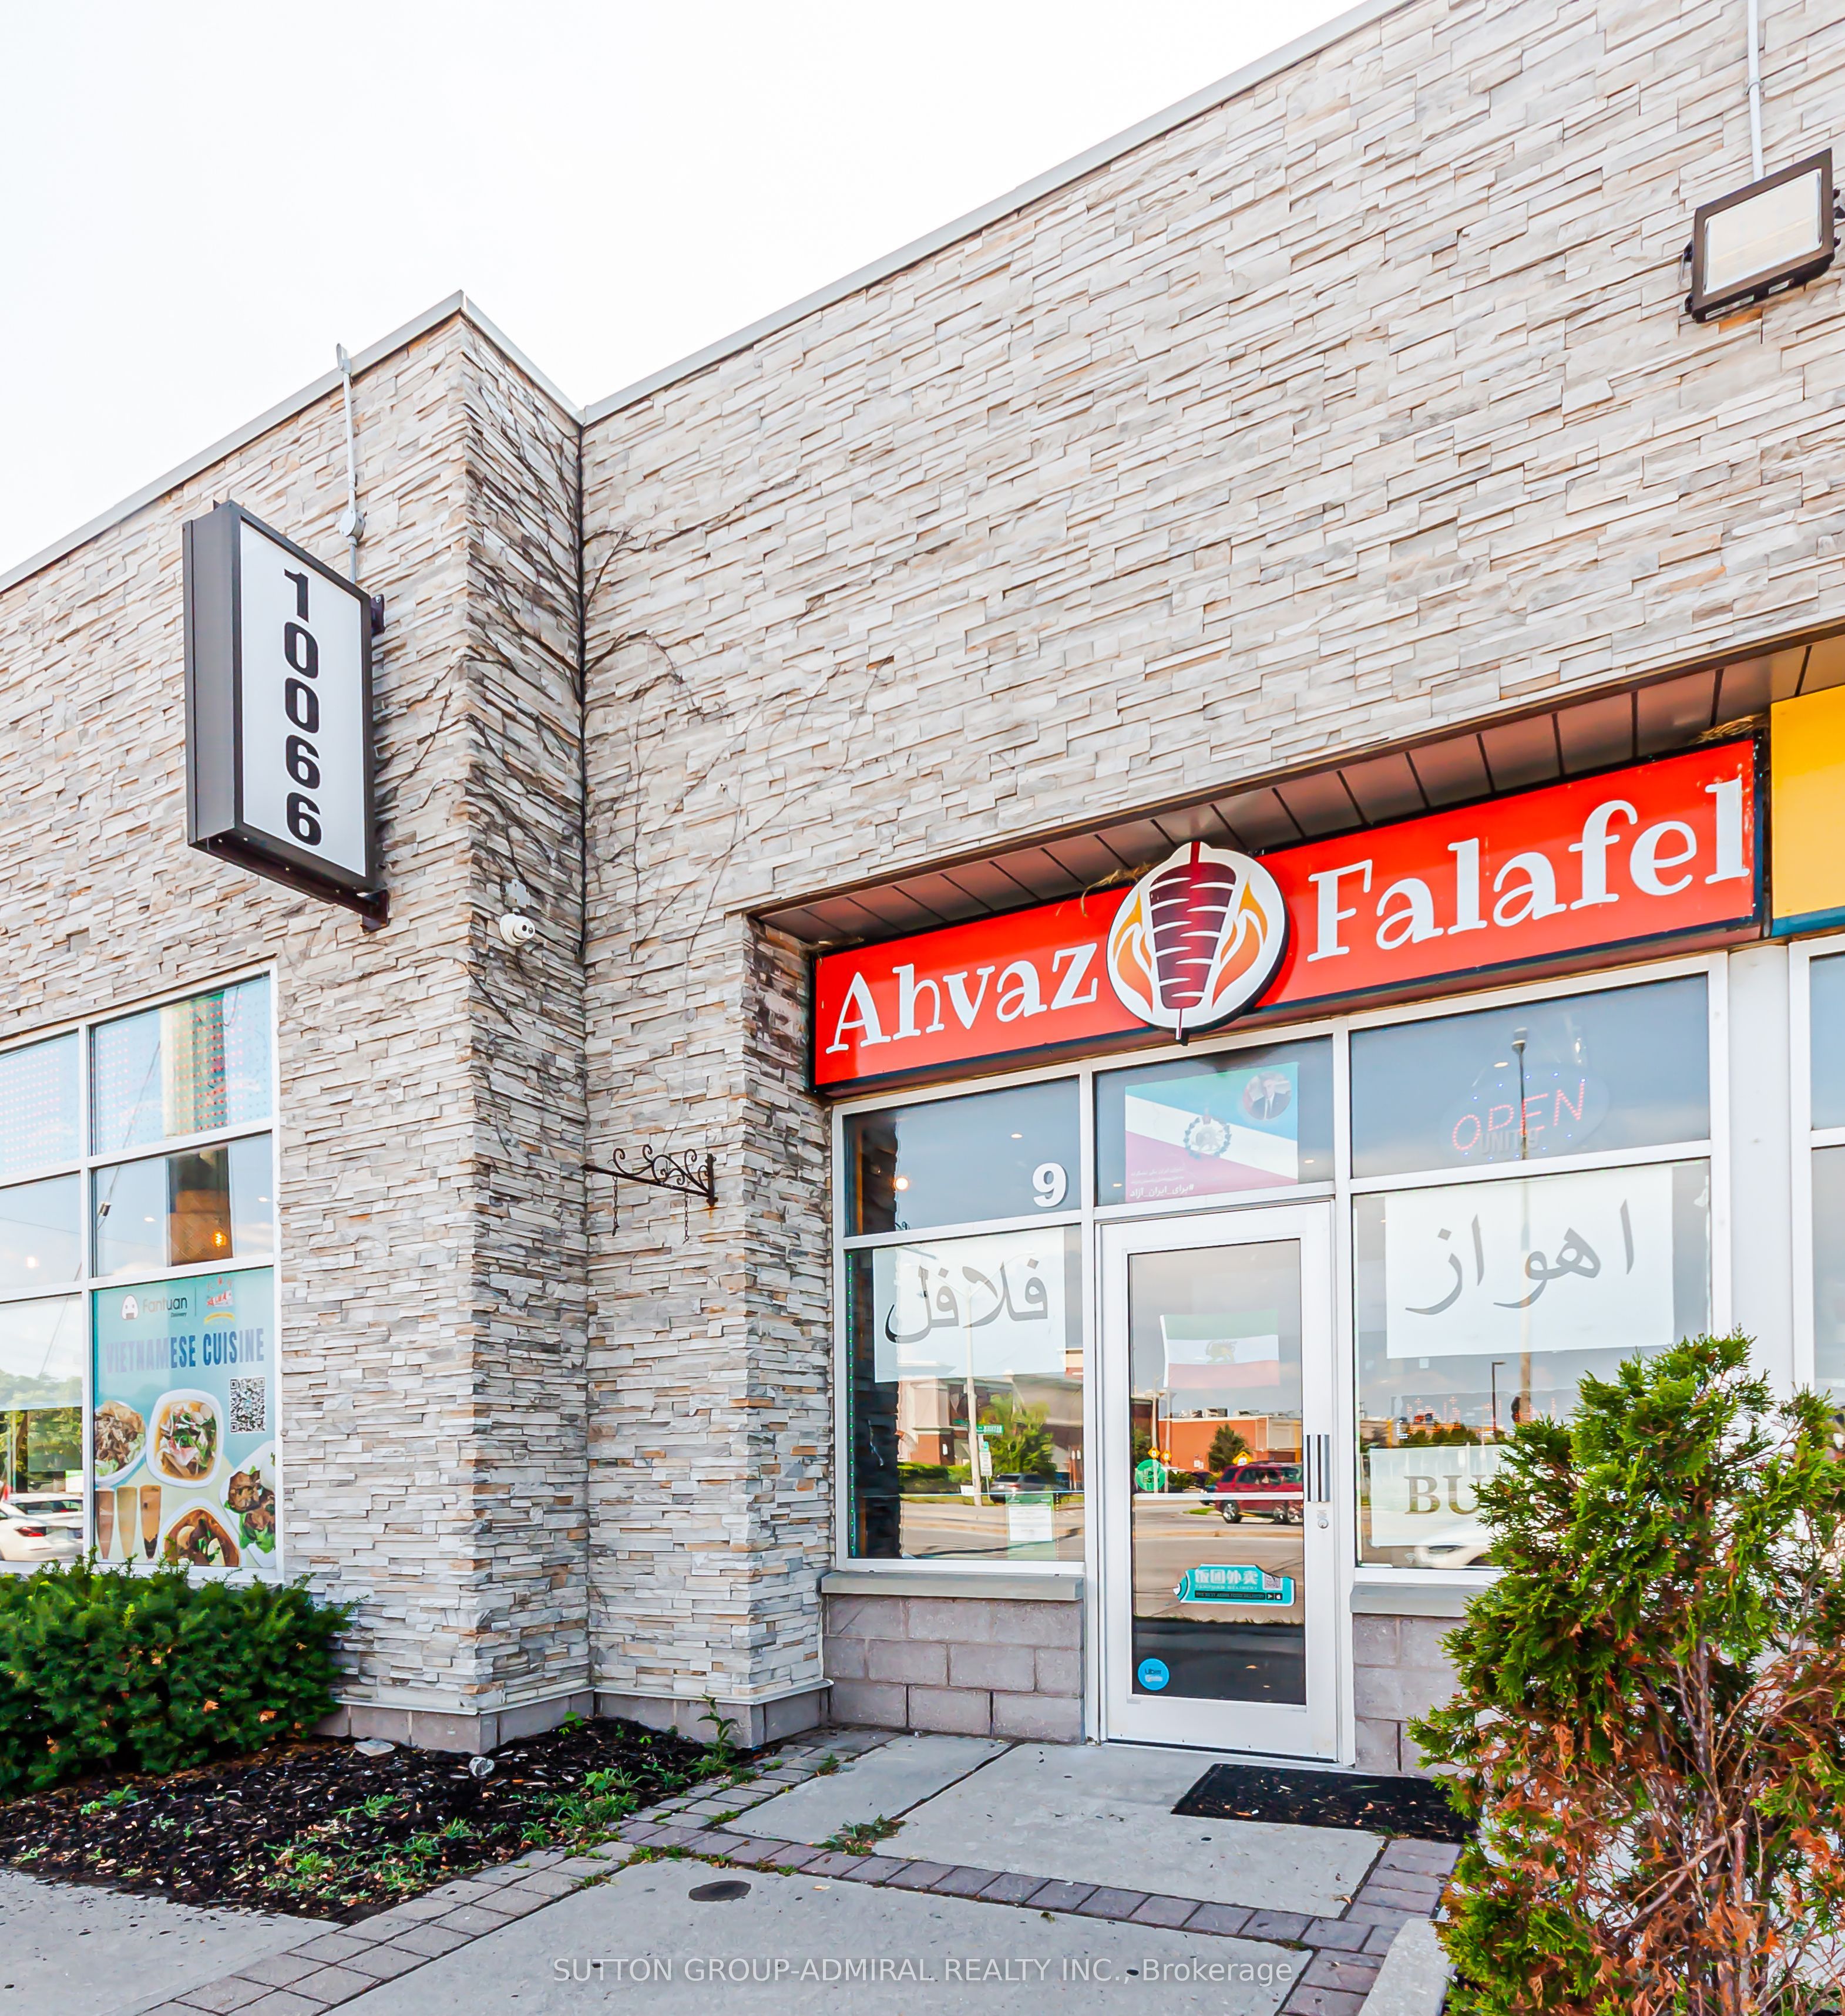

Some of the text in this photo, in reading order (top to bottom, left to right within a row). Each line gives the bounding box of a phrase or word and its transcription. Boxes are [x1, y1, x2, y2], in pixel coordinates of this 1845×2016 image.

[284, 568, 322, 846] 10066
[825, 777, 1750, 1055] Ahvaz Falafel
[1452, 1082, 1585, 1151] OPEN
[1032, 1162, 1067, 1207] 9
[885, 1258, 1049, 1344] فلافل
[106, 1328, 264, 1374] VIETNAMESE CUISINE
[1404, 1475, 1499, 1516] BU
